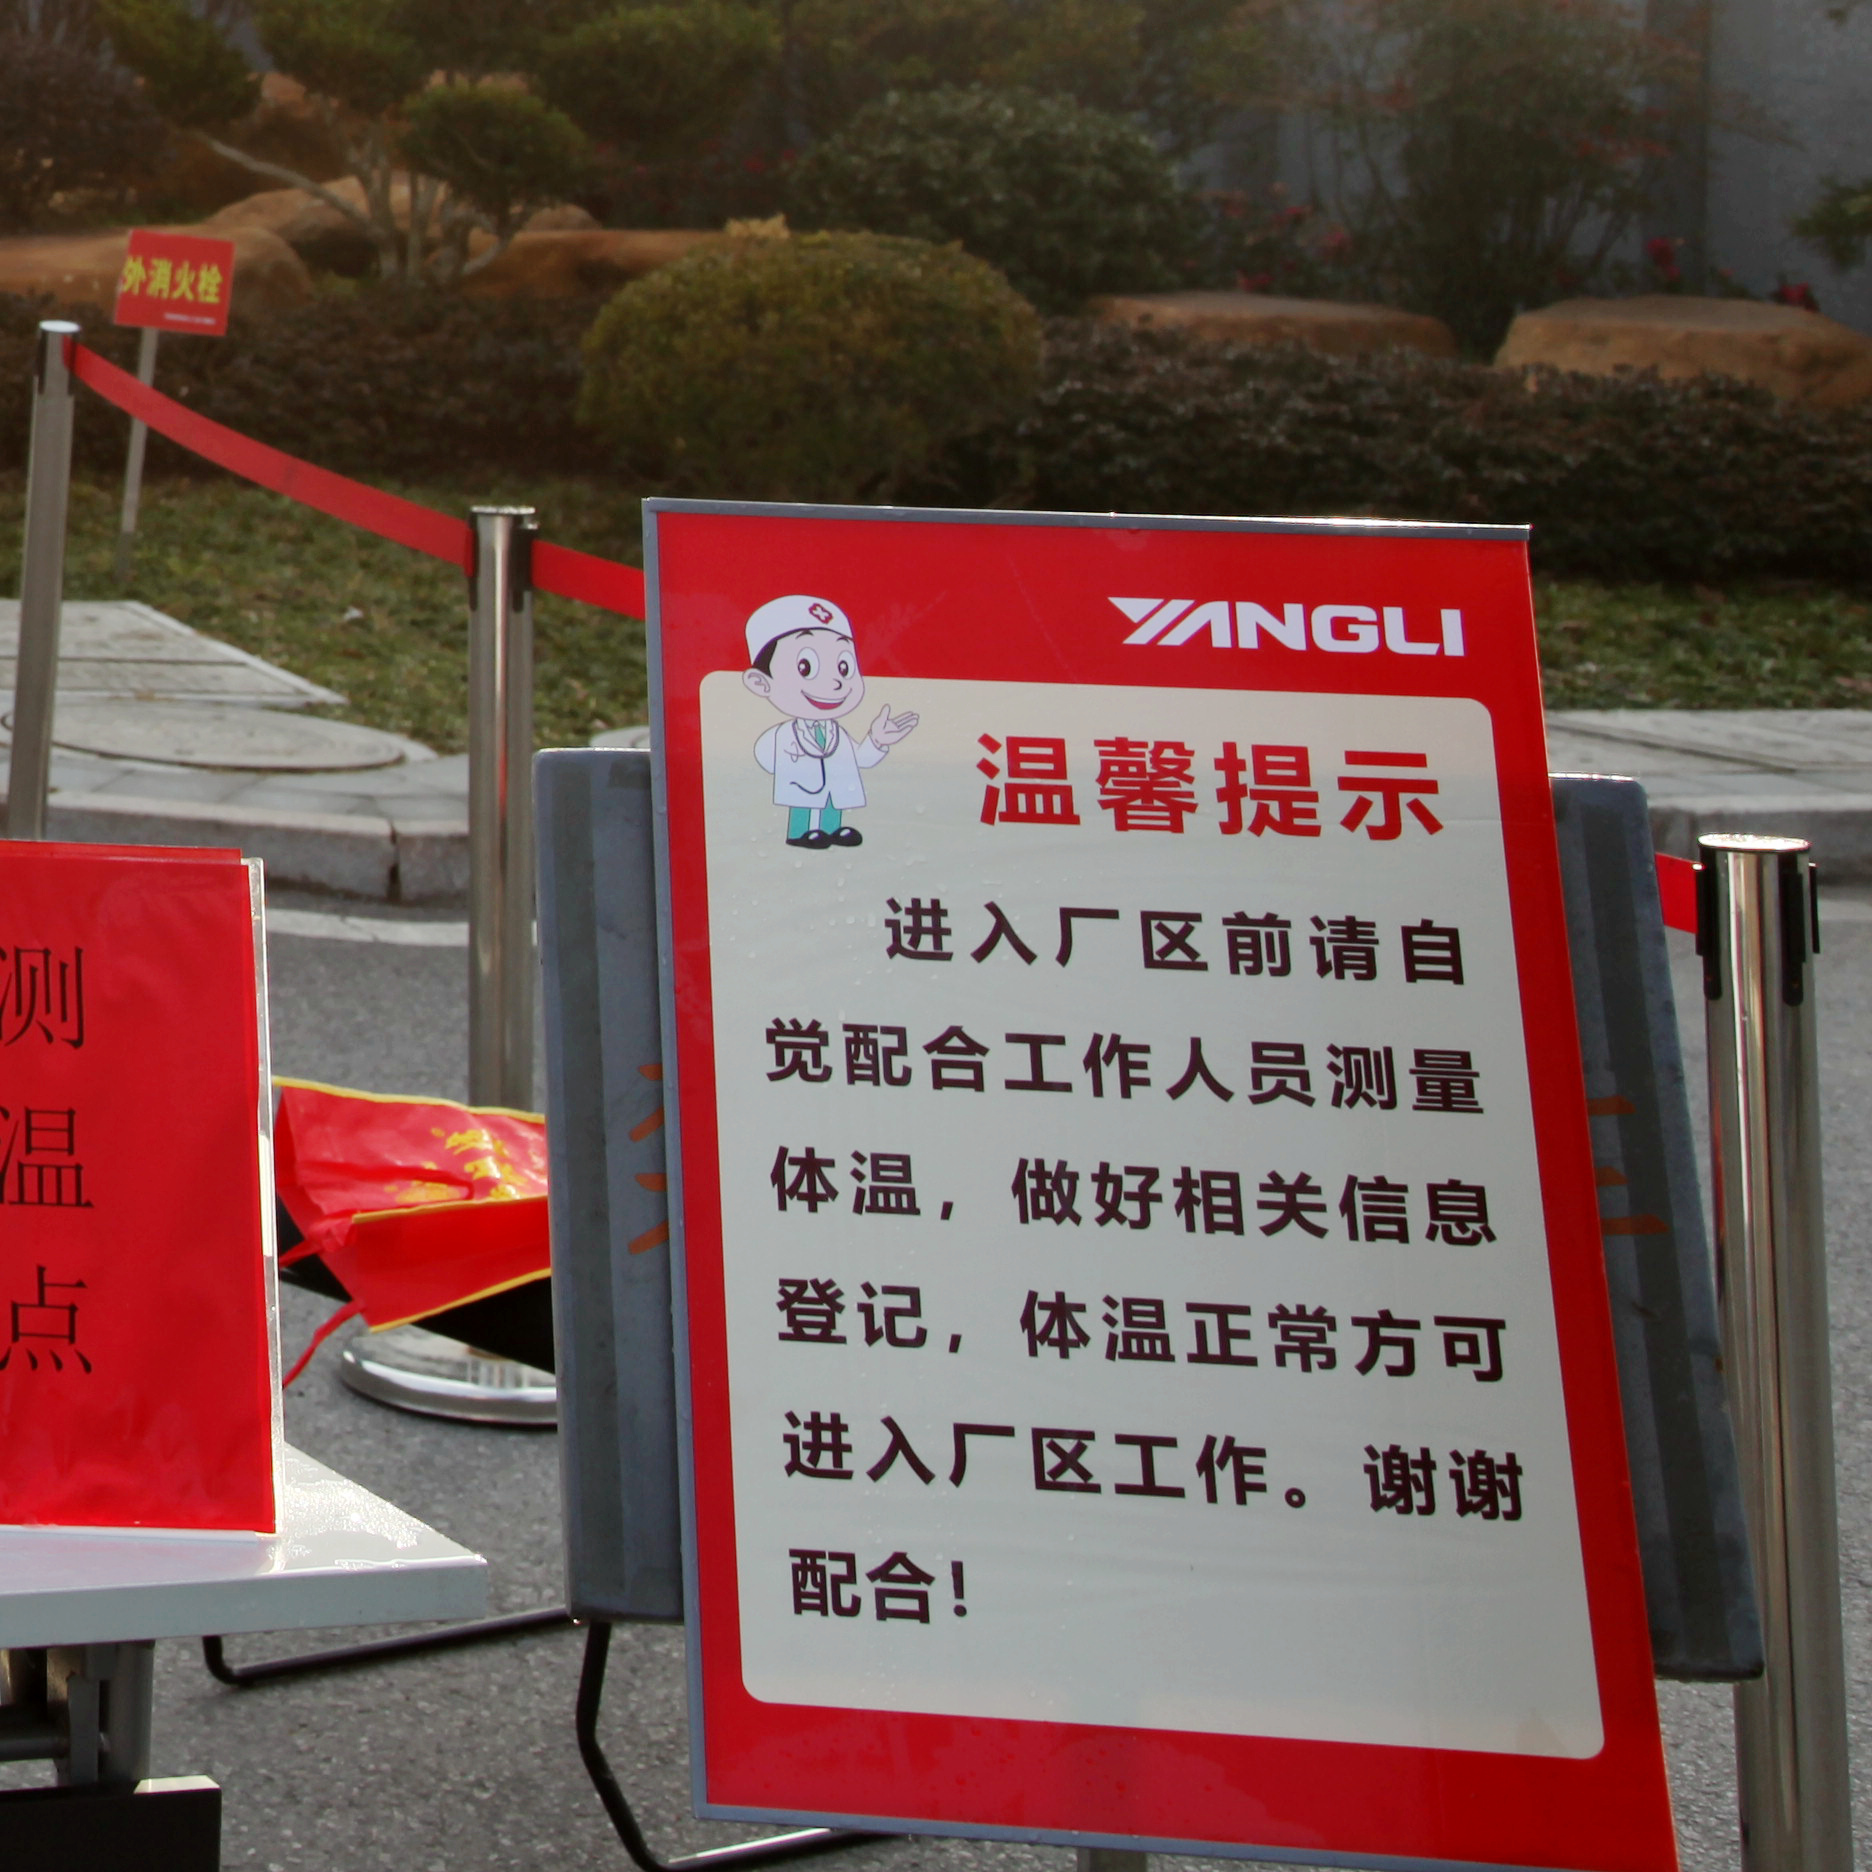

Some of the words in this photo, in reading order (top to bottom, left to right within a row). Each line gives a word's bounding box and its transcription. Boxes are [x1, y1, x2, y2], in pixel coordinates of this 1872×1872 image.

[1109, 597, 1464, 656] YANGLI
[977, 734, 1442, 840] 温馨提示
[885, 898, 1465, 986] 进入厂区前请自
[766, 1019, 1484, 1115] 觉配合工作人员测量
[771, 1147, 1497, 1247] 体温，做好相关信息
[777, 1279, 1507, 1383] 登记，体温正常方可
[783, 1412, 1523, 1522] 进入厂区工作。谢谢
